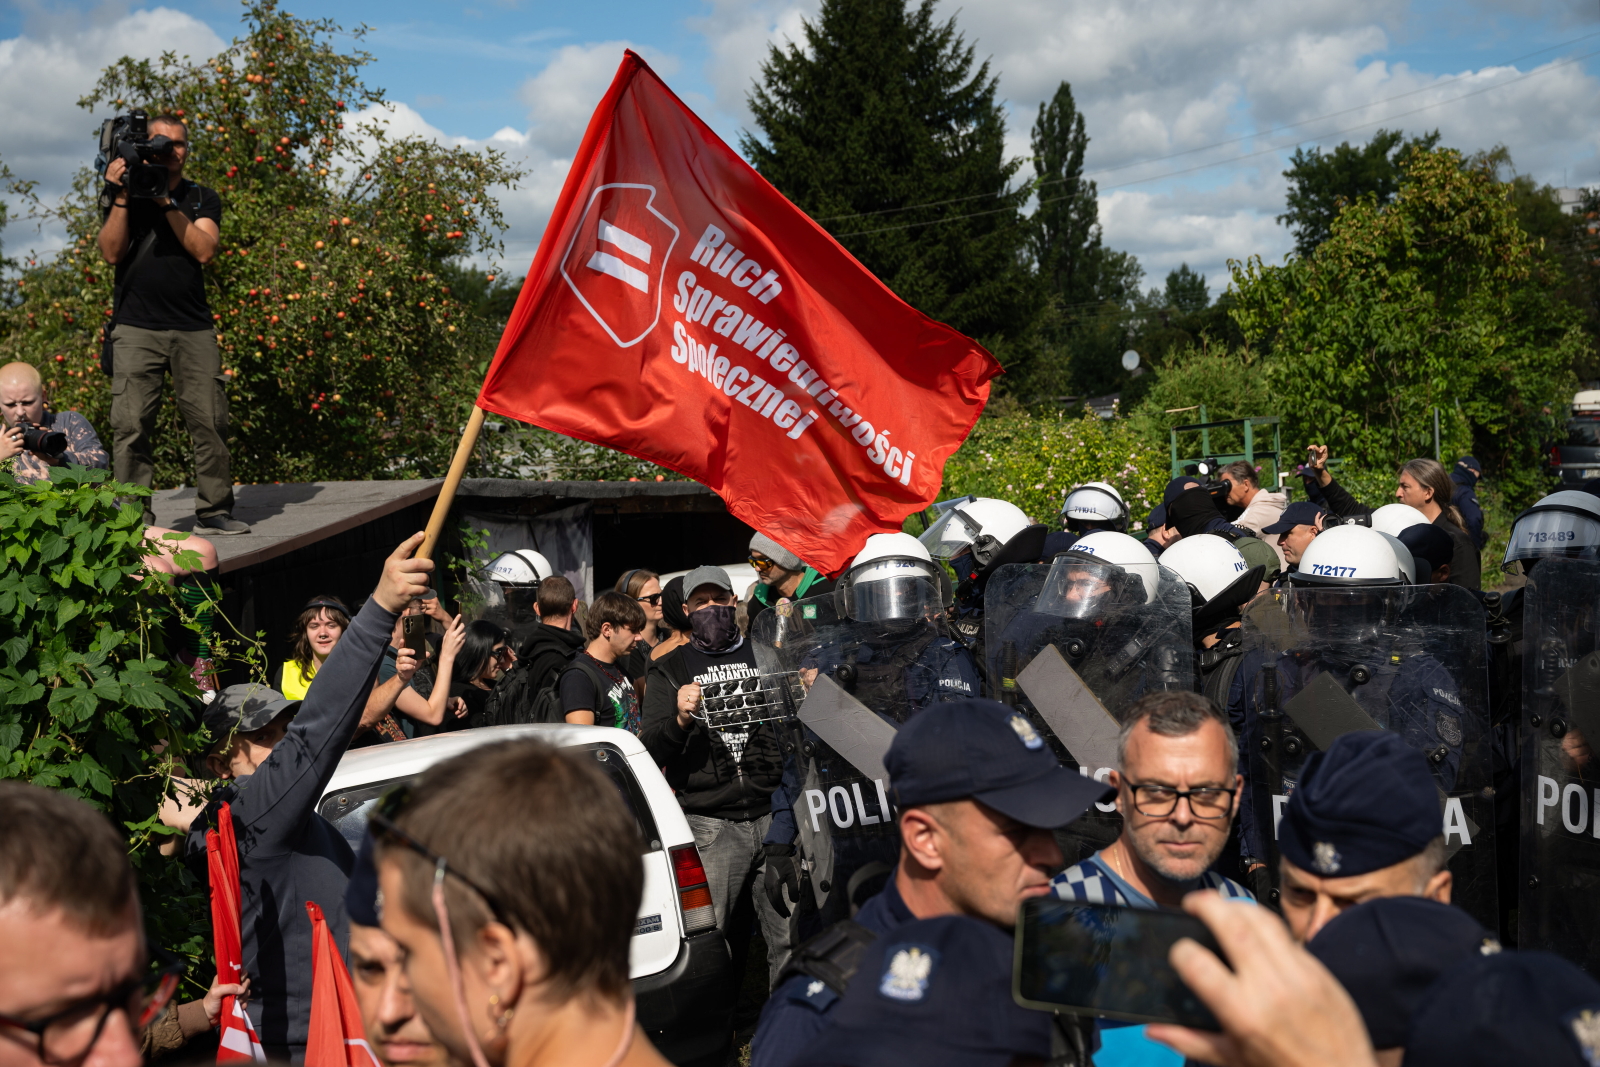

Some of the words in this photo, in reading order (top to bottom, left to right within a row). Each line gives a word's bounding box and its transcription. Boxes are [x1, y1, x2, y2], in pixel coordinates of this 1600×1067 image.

[690, 224, 783, 305] Ruch
[671, 321, 819, 440] Społecznej
[1528, 531, 1575, 543] 713489
[1312, 563, 1357, 578] 712177
[707, 665, 719, 673] NA
[720, 662, 748, 671] PEWNO
[805, 778, 898, 833] POLI
